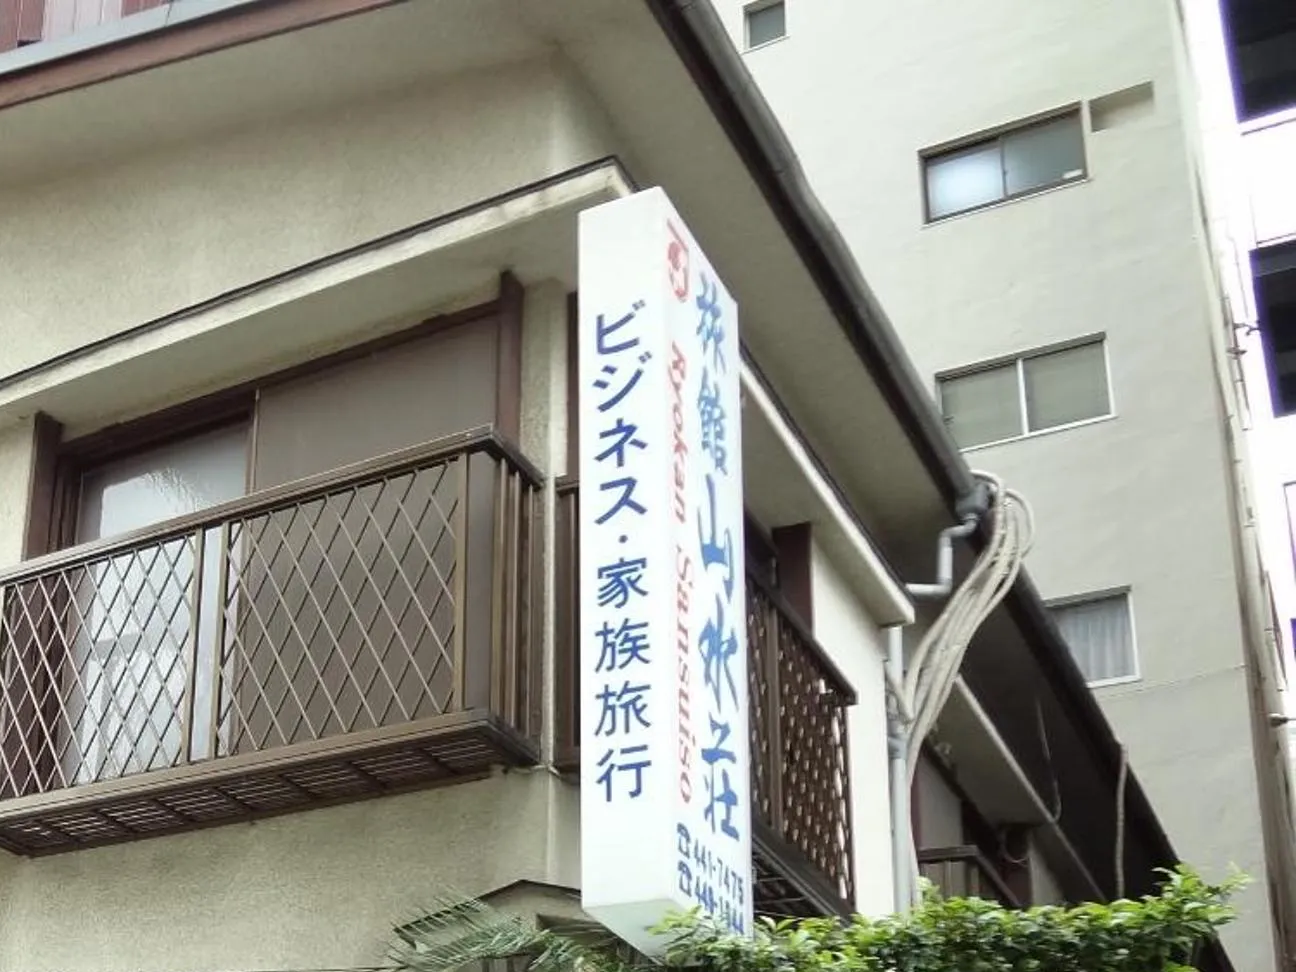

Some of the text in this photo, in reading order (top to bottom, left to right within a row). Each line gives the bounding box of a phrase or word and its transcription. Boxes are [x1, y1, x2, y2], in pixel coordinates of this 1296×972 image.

[593, 299, 653, 803] ビジネス・家族旅行
[667, 340, 696, 804] Ryokan Sansuiso
